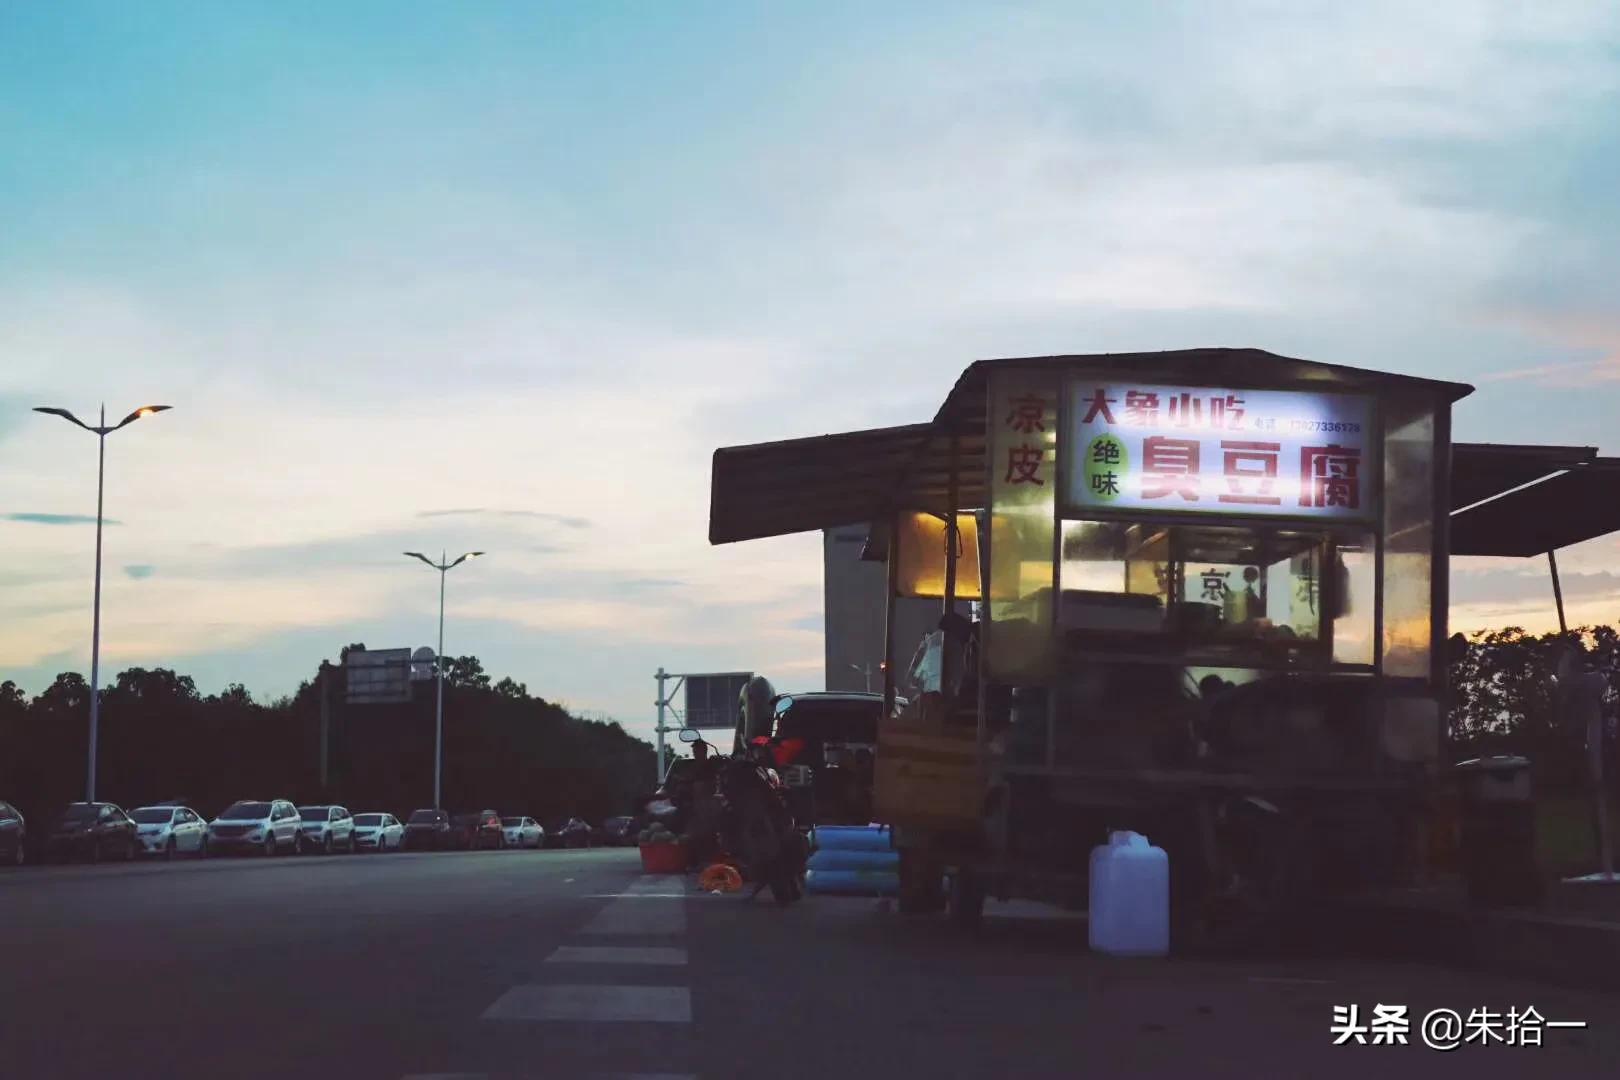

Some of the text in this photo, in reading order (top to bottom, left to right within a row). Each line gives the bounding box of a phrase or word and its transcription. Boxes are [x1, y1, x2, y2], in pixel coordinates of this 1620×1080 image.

[1081, 389, 1246, 432] 大象小吃
[1092, 442, 1120, 496] 绝味
[1141, 436, 1362, 509] 臭豆腐
